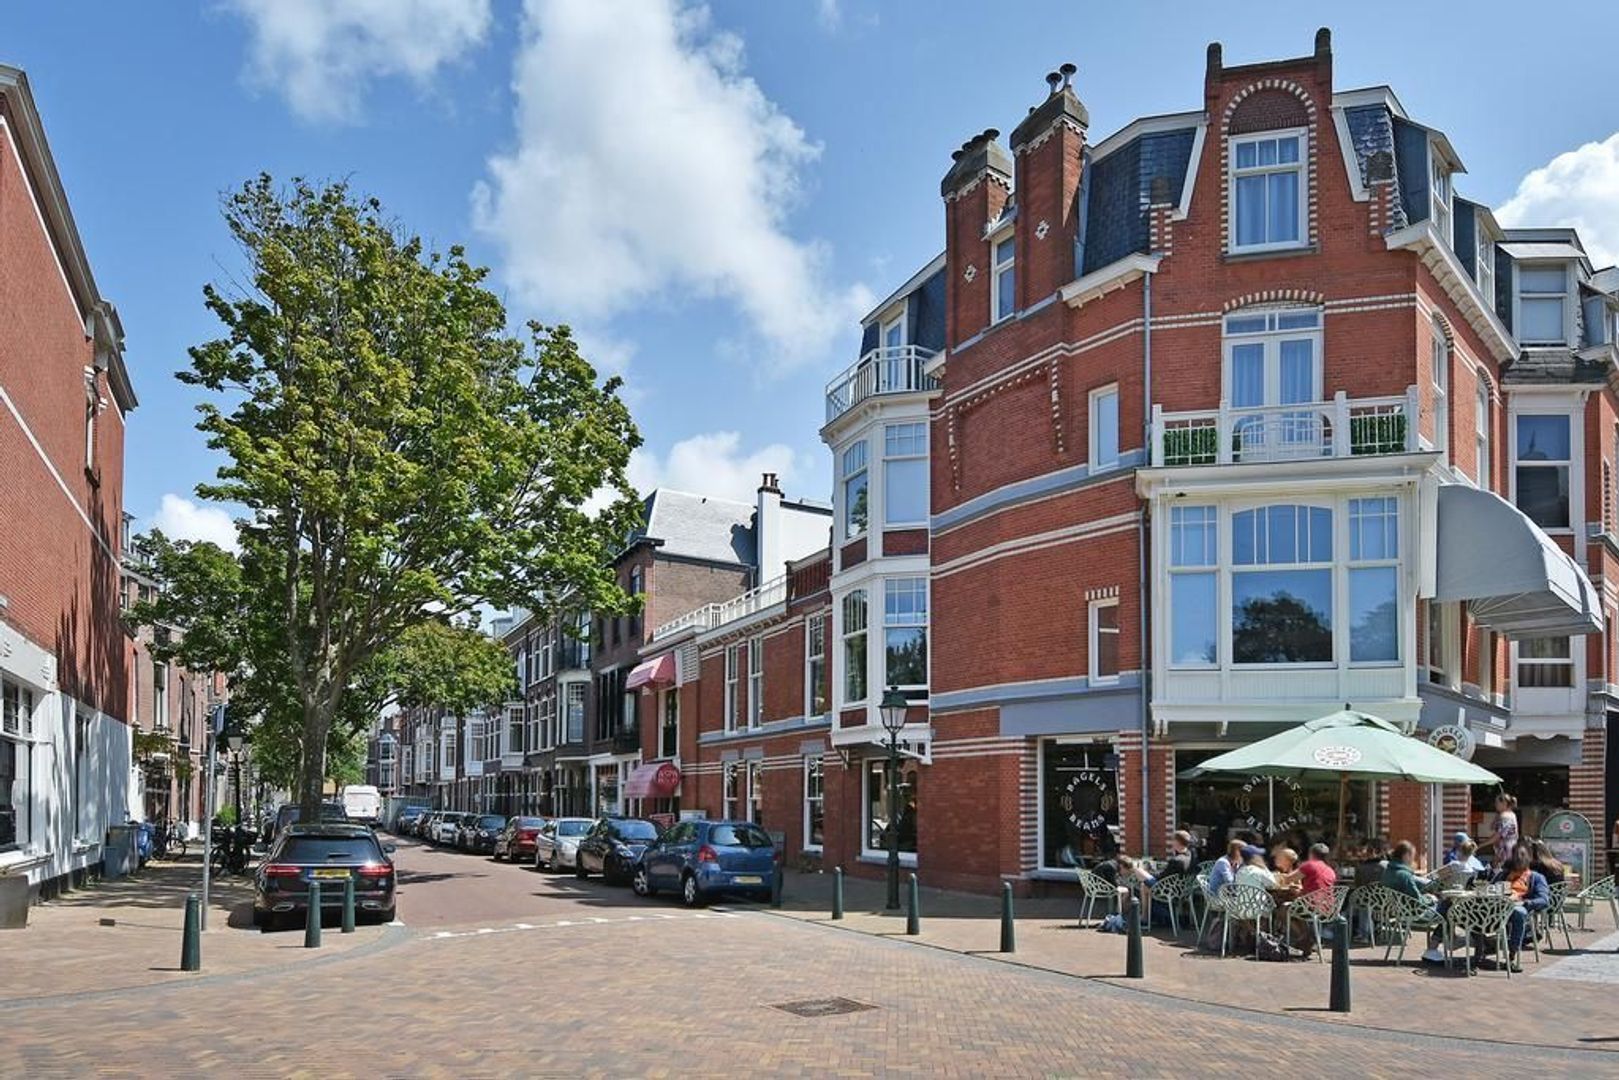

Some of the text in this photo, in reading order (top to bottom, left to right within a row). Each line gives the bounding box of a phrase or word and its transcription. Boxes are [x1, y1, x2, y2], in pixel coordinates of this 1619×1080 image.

[1066, 771, 1107, 792] BAGELS
[1068, 813, 1105, 831] BEANS
[1246, 815, 1298, 833] BEANS
